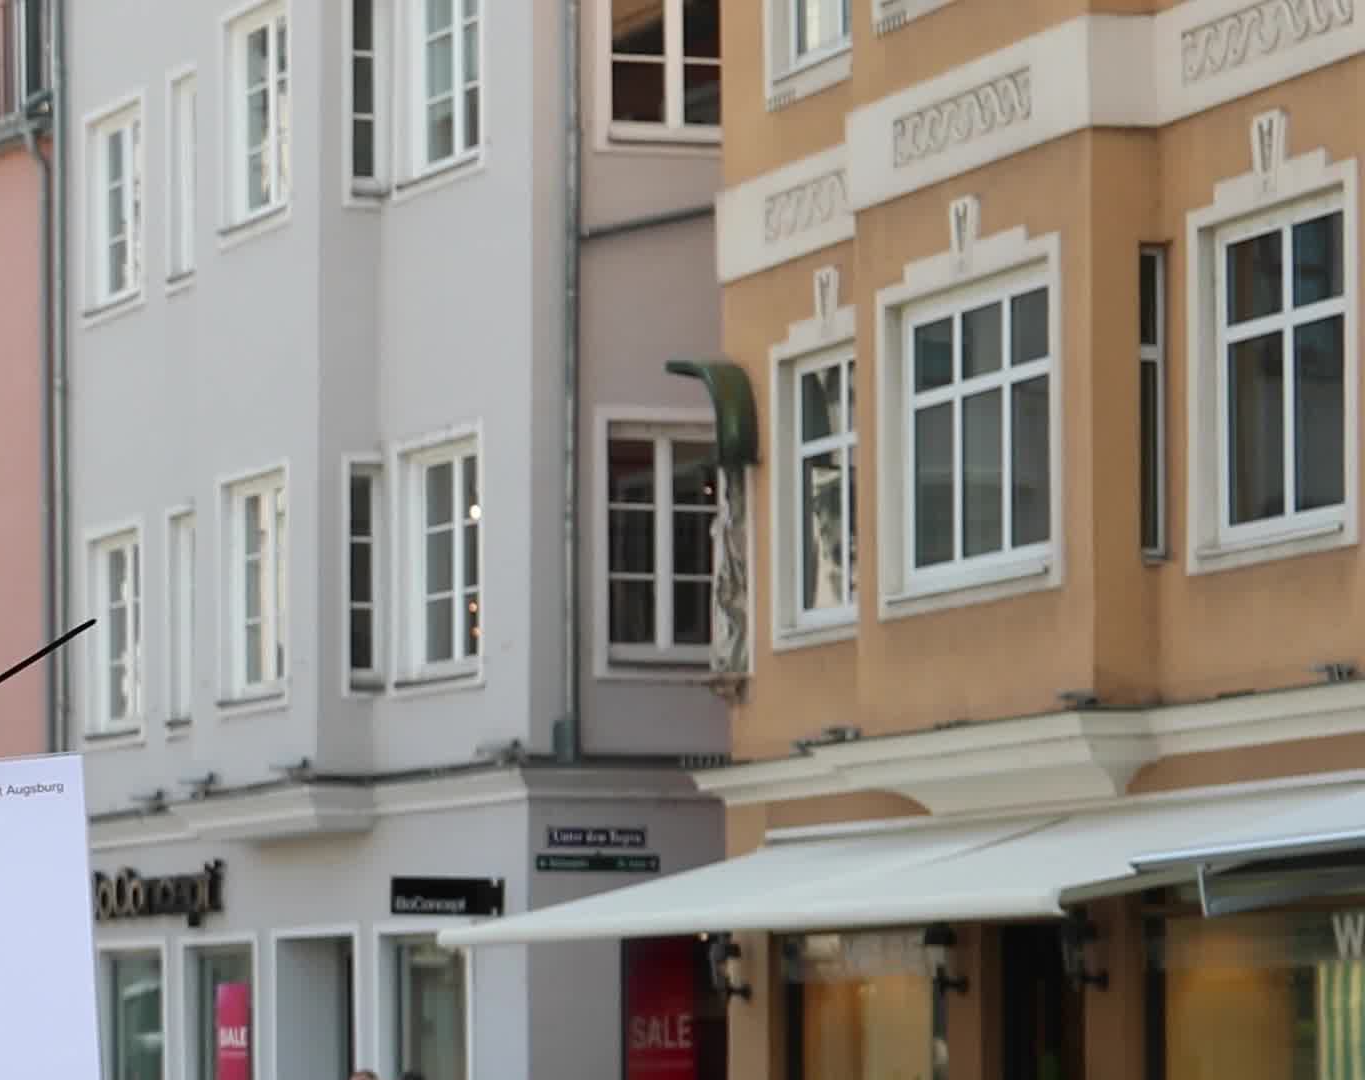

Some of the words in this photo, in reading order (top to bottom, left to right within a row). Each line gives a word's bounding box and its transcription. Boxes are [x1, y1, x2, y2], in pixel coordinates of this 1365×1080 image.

[7, 781, 64, 797] Augsburg
[94, 860, 224, 926] oConcept
[630, 1014, 693, 1050] SALE
